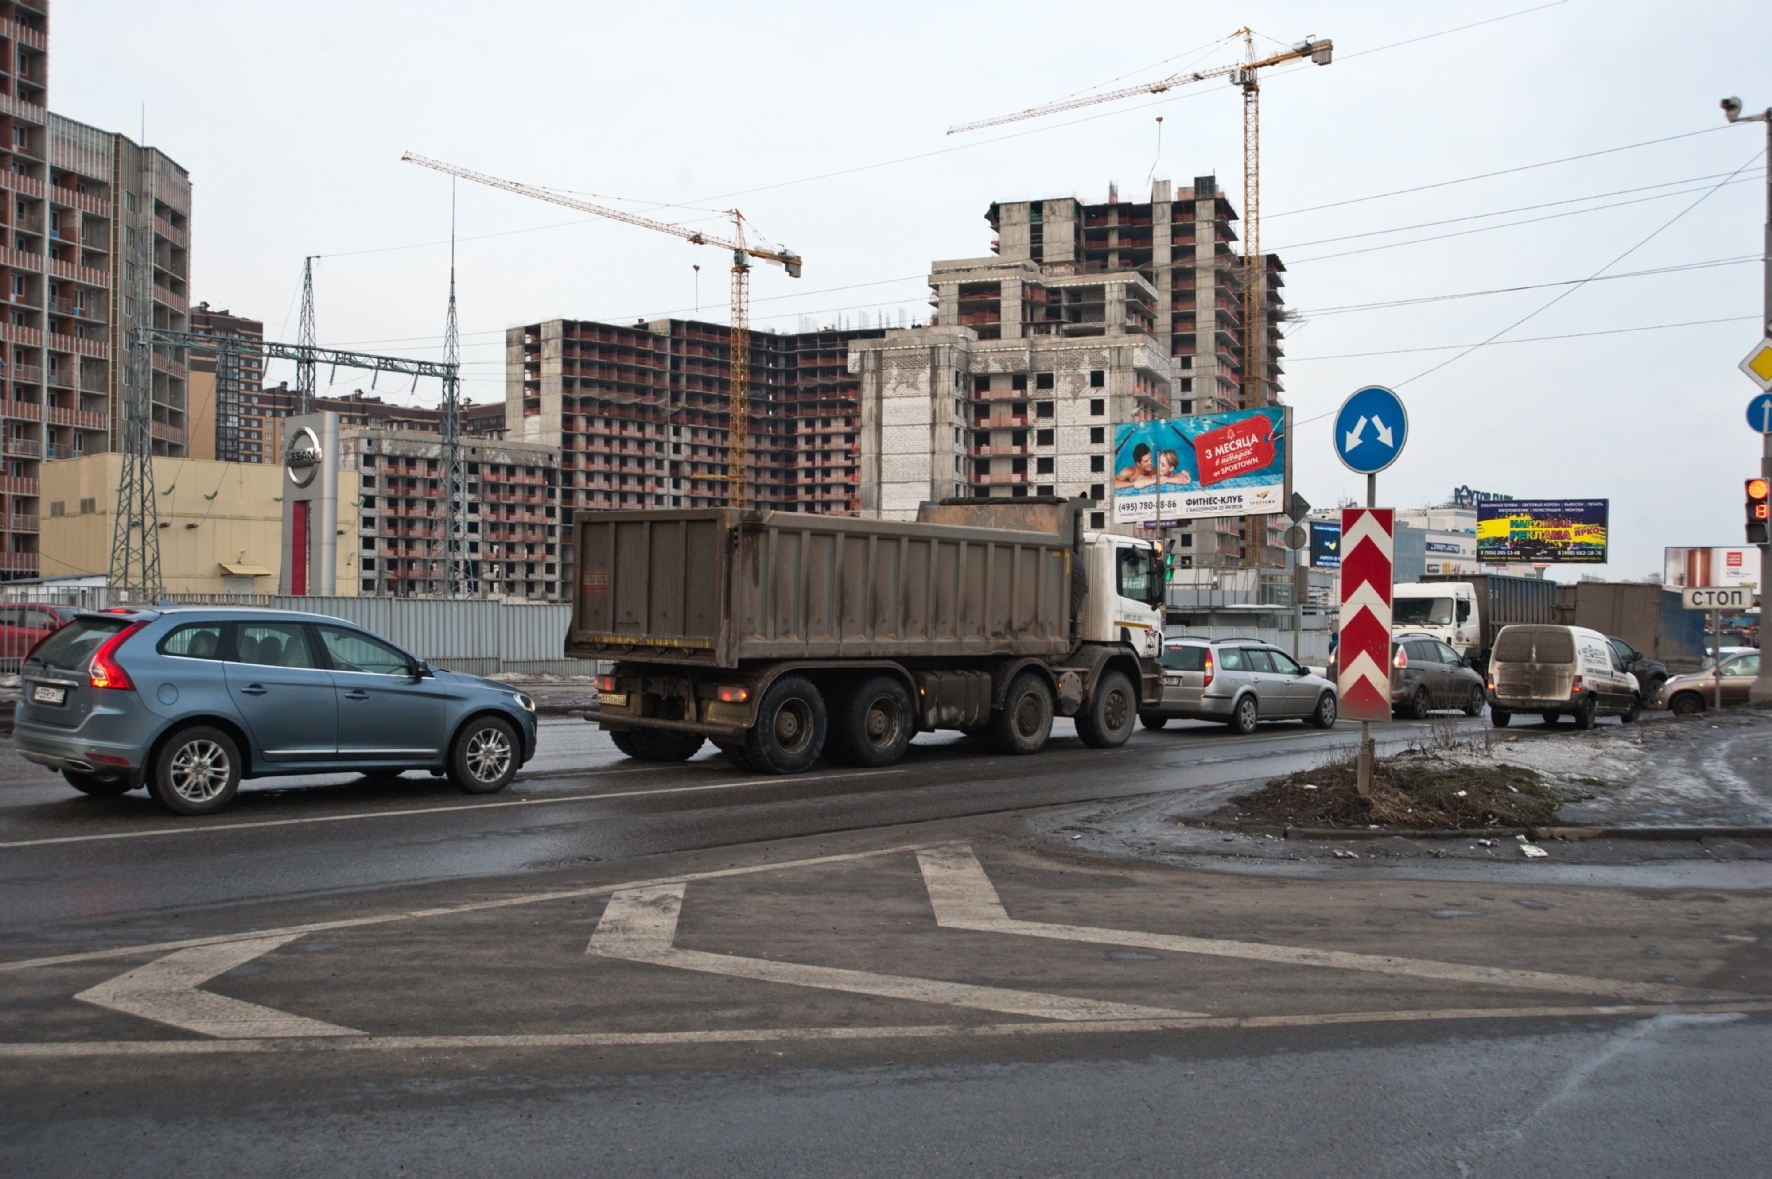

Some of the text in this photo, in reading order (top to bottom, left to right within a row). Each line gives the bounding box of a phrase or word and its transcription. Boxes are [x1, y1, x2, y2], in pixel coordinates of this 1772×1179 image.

[1205, 434, 1259, 459] 3 МЕСЯЦА
[287, 450, 316, 462] SSAN
[1221, 447, 1253, 465] подарок
[1221, 457, 1259, 475] SPORTOWN
[1185, 495, 1243, 506] ФИТНЕС-КЛУБ
[1118, 502, 1137, 513] (495)
[1510, 519, 1572, 528] НАРУЖНАЯ
[1510, 530, 1571, 540] РЕКЛАМА
[1574, 527, 1600, 536] ЯРКО
[1692, 591, 1742, 606] СТОП
